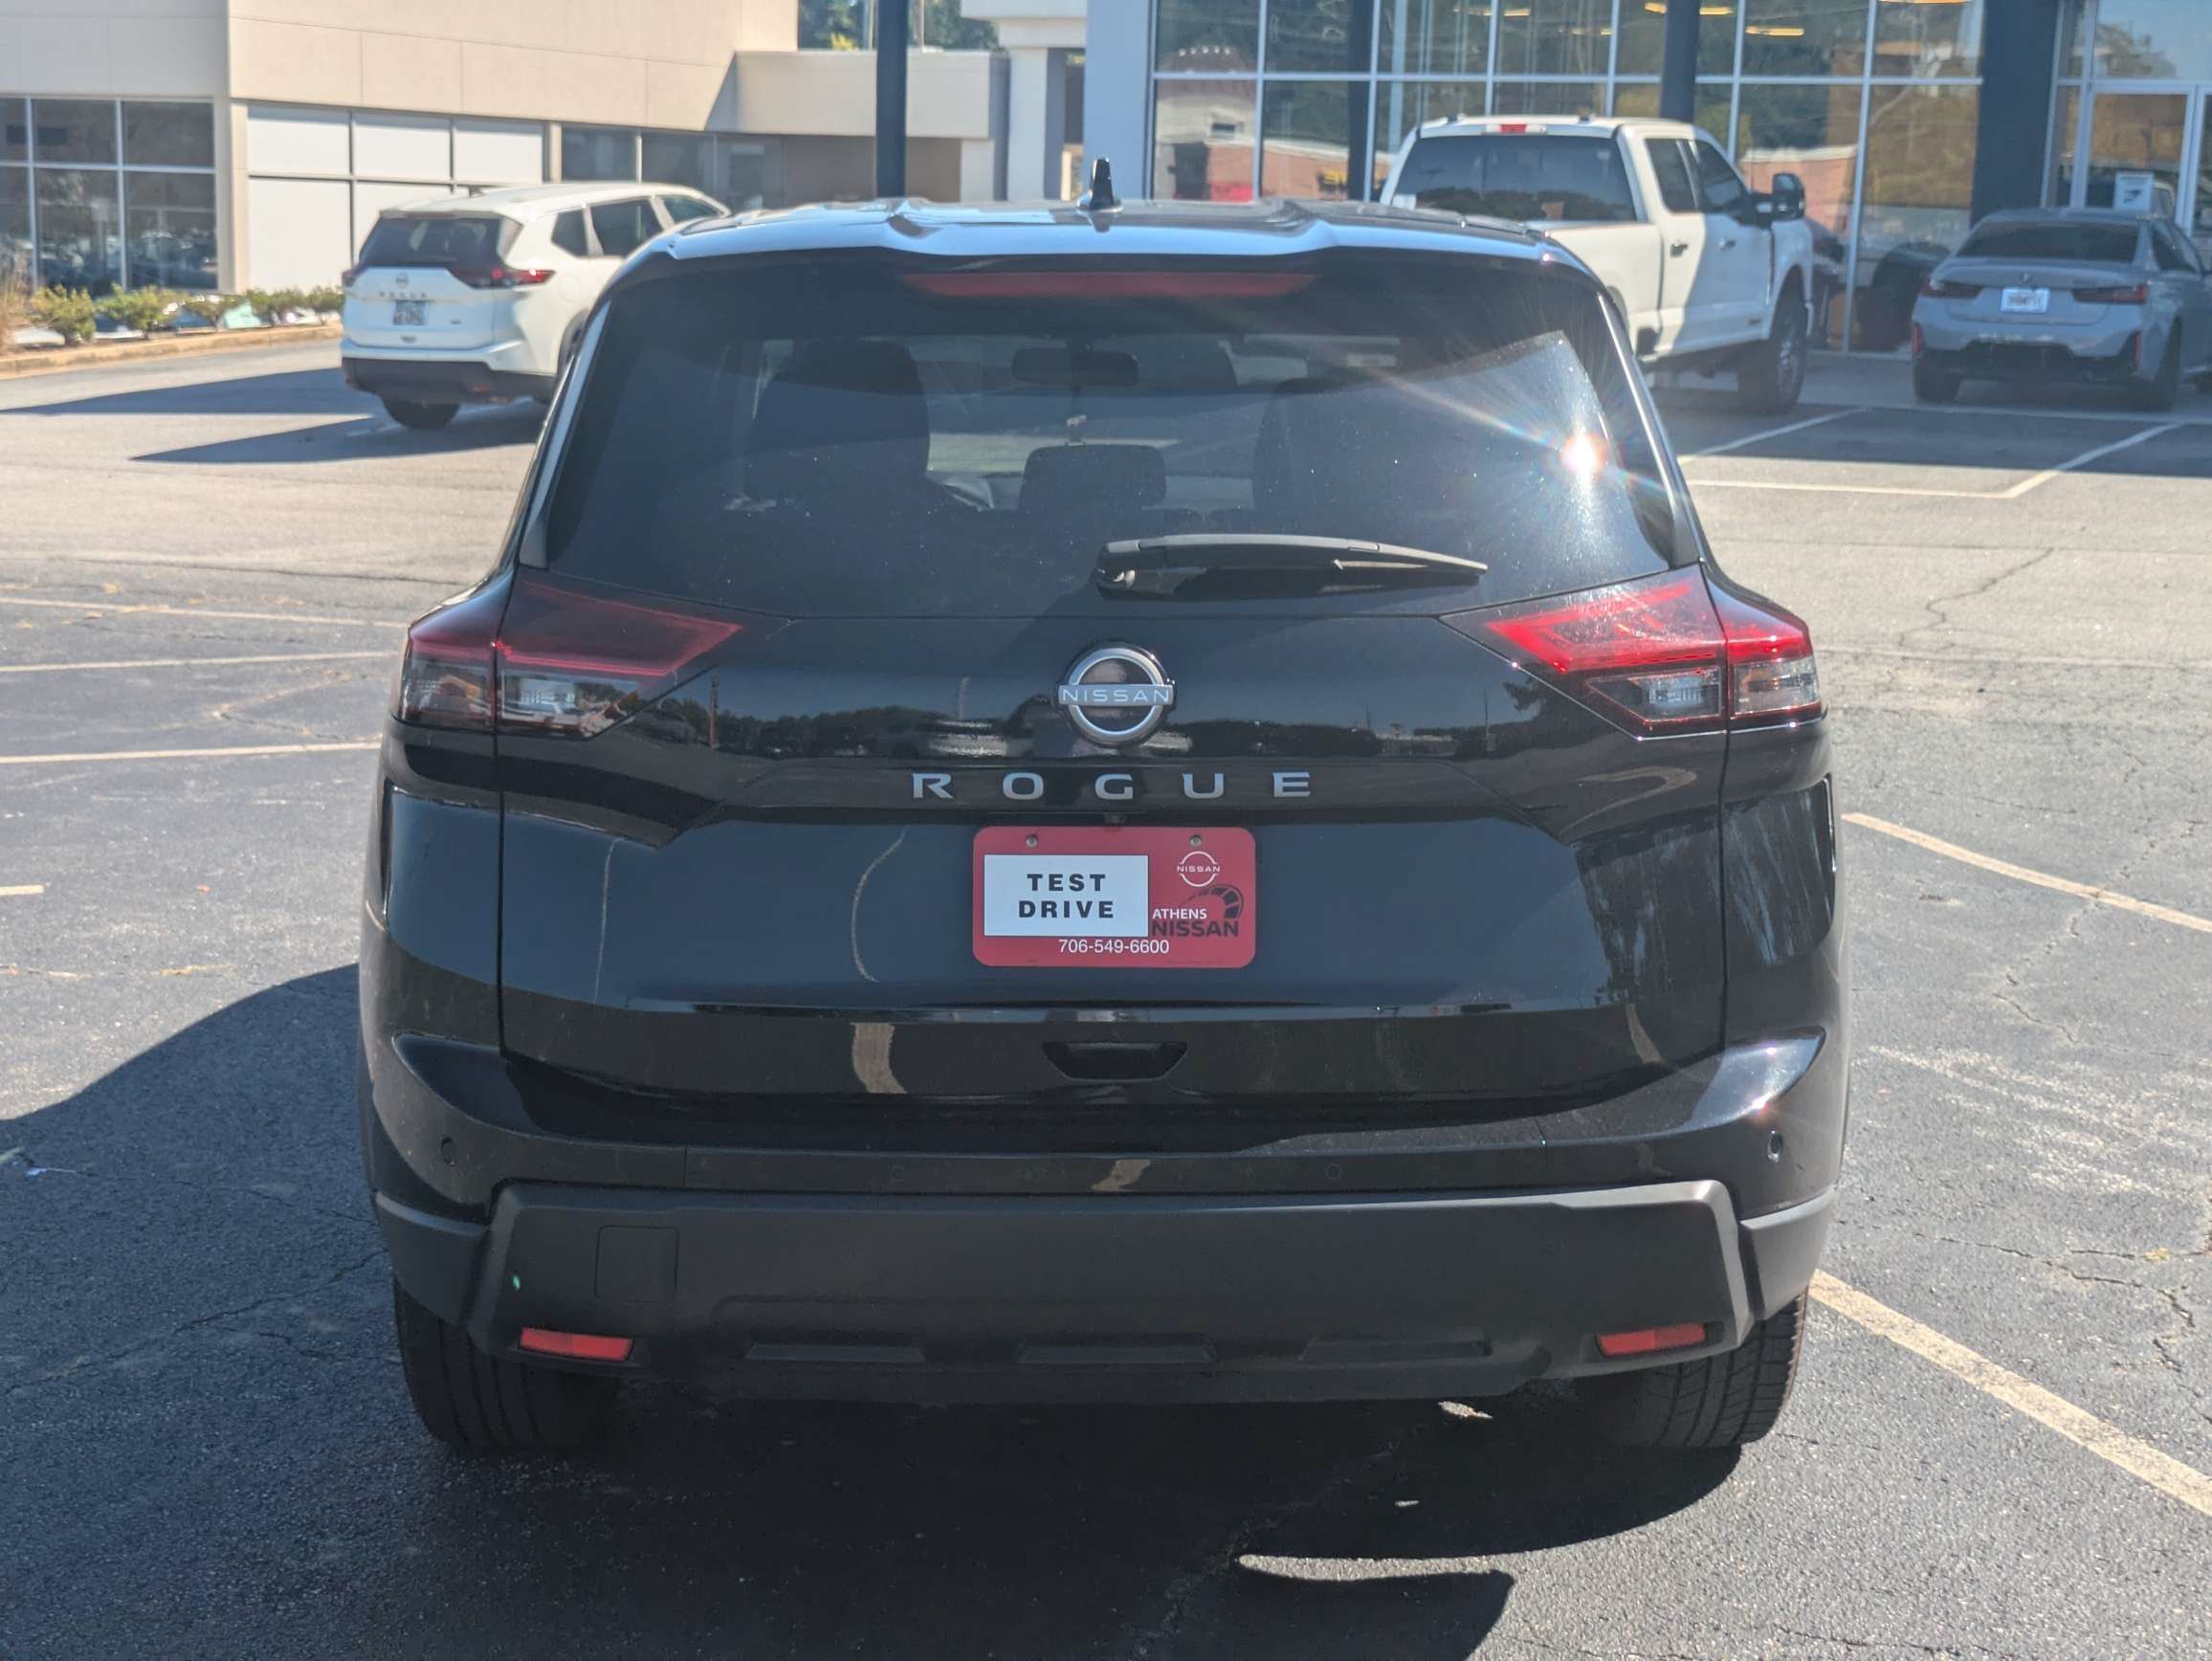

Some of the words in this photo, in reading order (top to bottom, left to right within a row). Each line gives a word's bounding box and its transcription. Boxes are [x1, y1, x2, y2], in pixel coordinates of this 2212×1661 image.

[1062, 689, 1169, 702] NISSAN
[912, 771, 1311, 800] ROGUE
[1176, 865, 1221, 874] NISSAN
[1027, 873, 1107, 892] TEST
[1018, 900, 1114, 919] DRIVE
[1152, 908, 1207, 920] ATHENS
[1151, 920, 1239, 938] NISSAN
[1058, 939, 1170, 954] 706-549-6600
